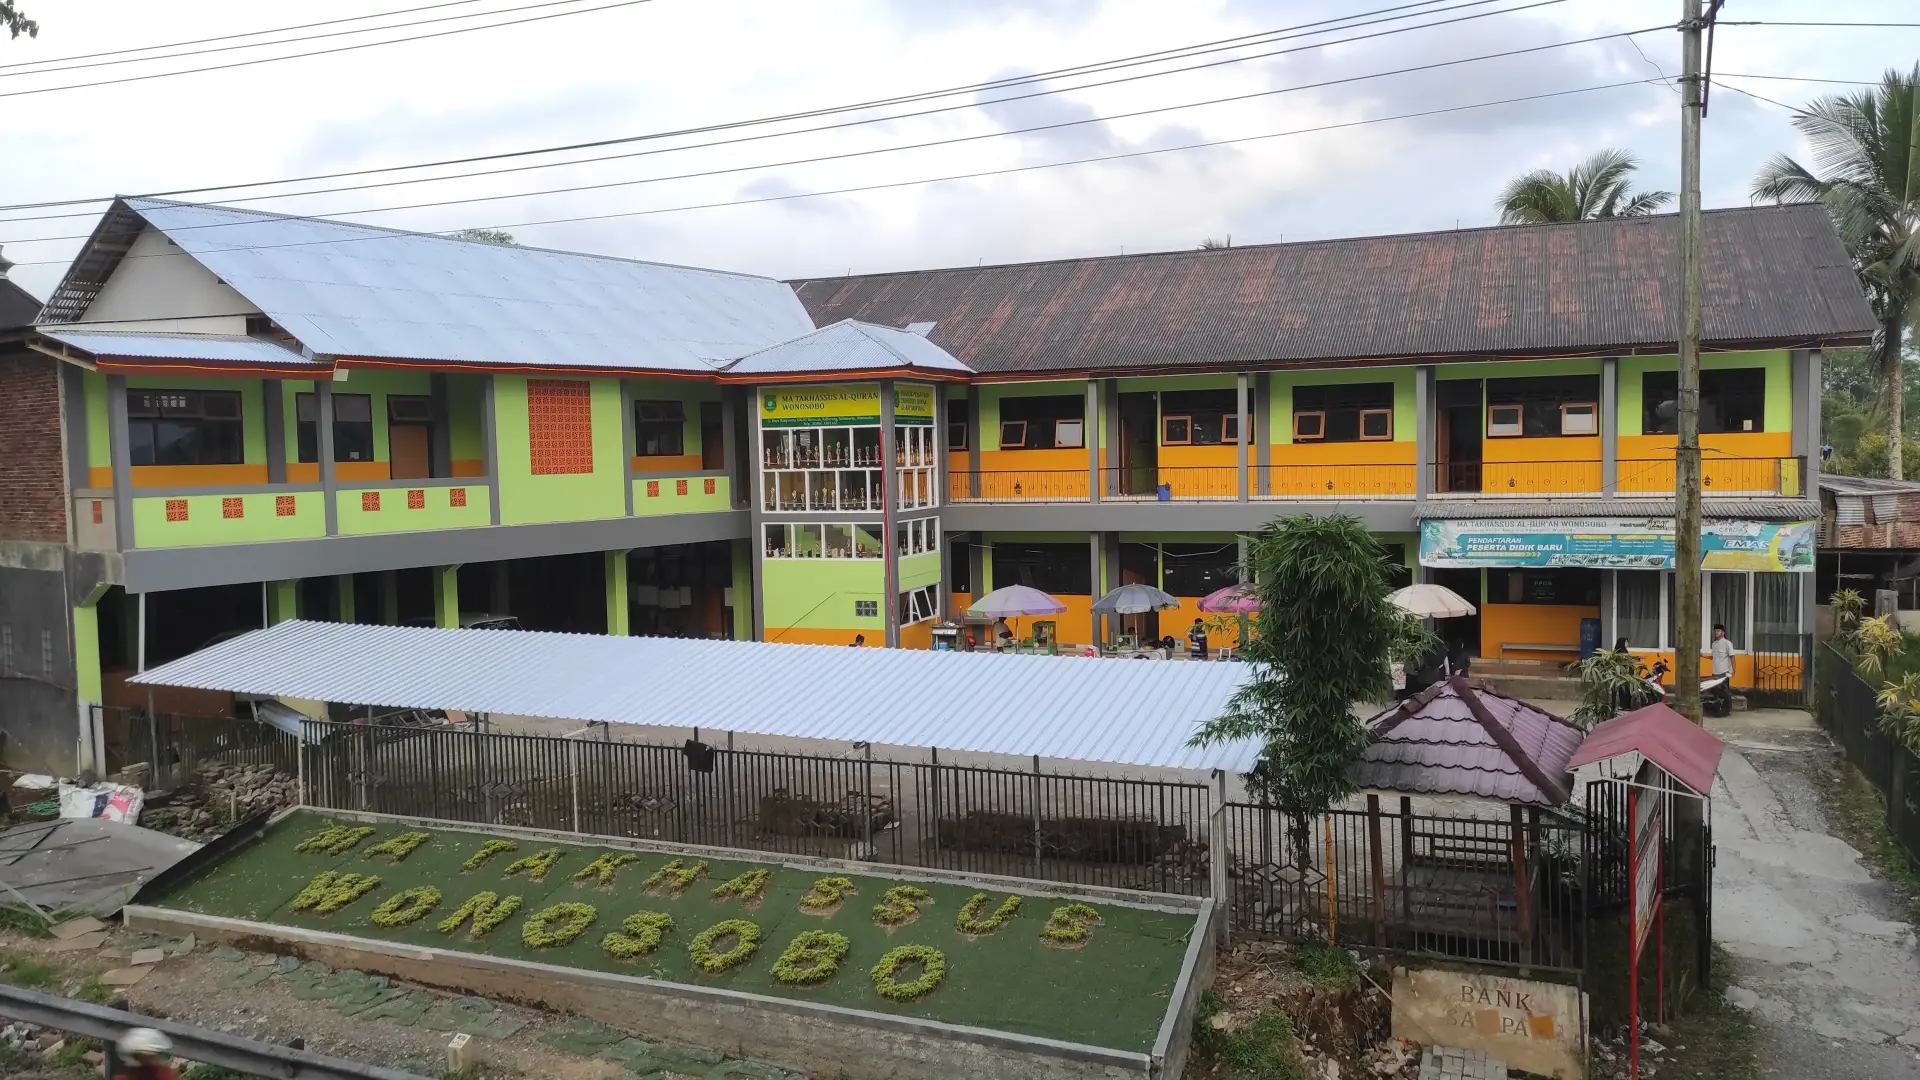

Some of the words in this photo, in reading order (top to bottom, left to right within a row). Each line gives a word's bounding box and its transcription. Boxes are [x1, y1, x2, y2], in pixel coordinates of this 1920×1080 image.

[795, 393, 837, 402] TAKHASSUS
[839, 392, 879, 401] AL-QUR'AN
[782, 402, 825, 411] WONOSOBO
[1561, 520, 1607, 528] WONOSOBO
[1724, 539, 1769, 548] EMAS
[288, 870, 947, 1001] WONOSOBO
[1461, 985, 1531, 1011] BANK
